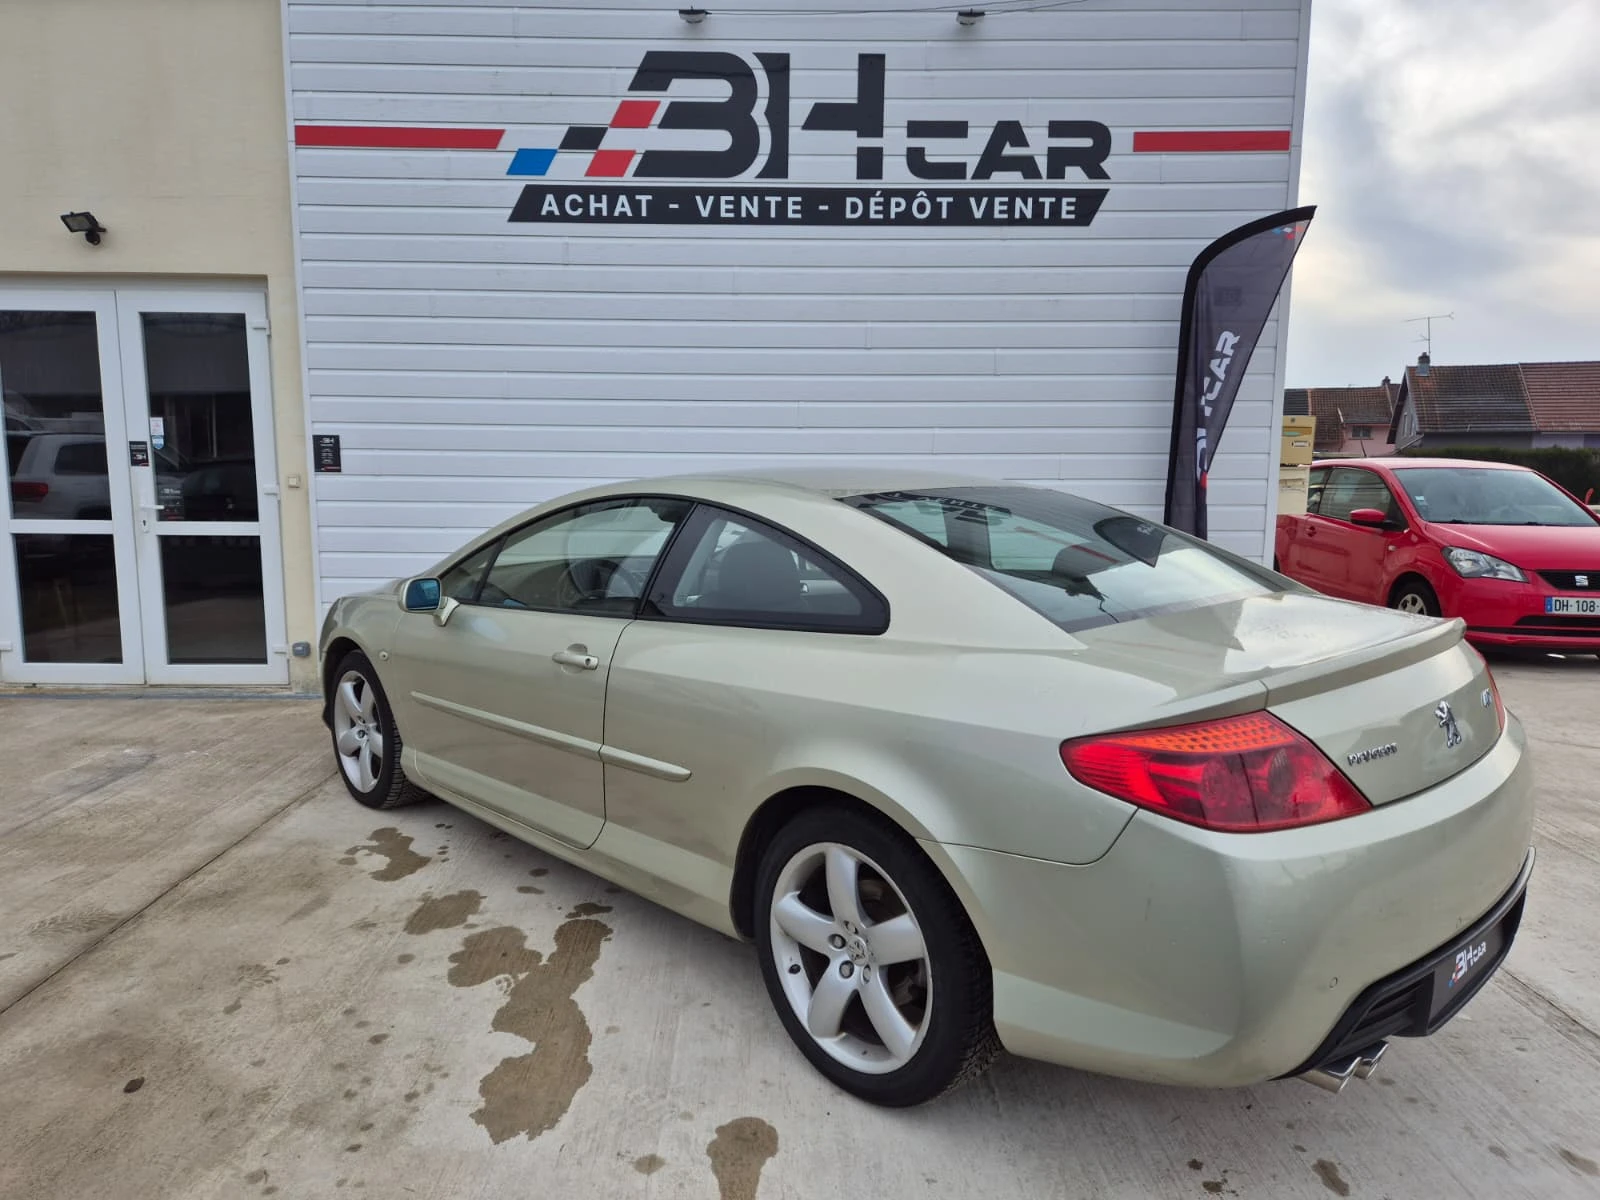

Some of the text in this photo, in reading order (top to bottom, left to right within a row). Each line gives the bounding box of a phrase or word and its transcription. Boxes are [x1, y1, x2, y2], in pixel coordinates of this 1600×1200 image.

[627, 51, 1112, 180] BH CAR
[541, 194, 654, 217] ACHAT
[696, 195, 803, 219] VENTE
[845, 190, 954, 220] DÉPÔT
[969, 196, 1077, 220] VENTE
